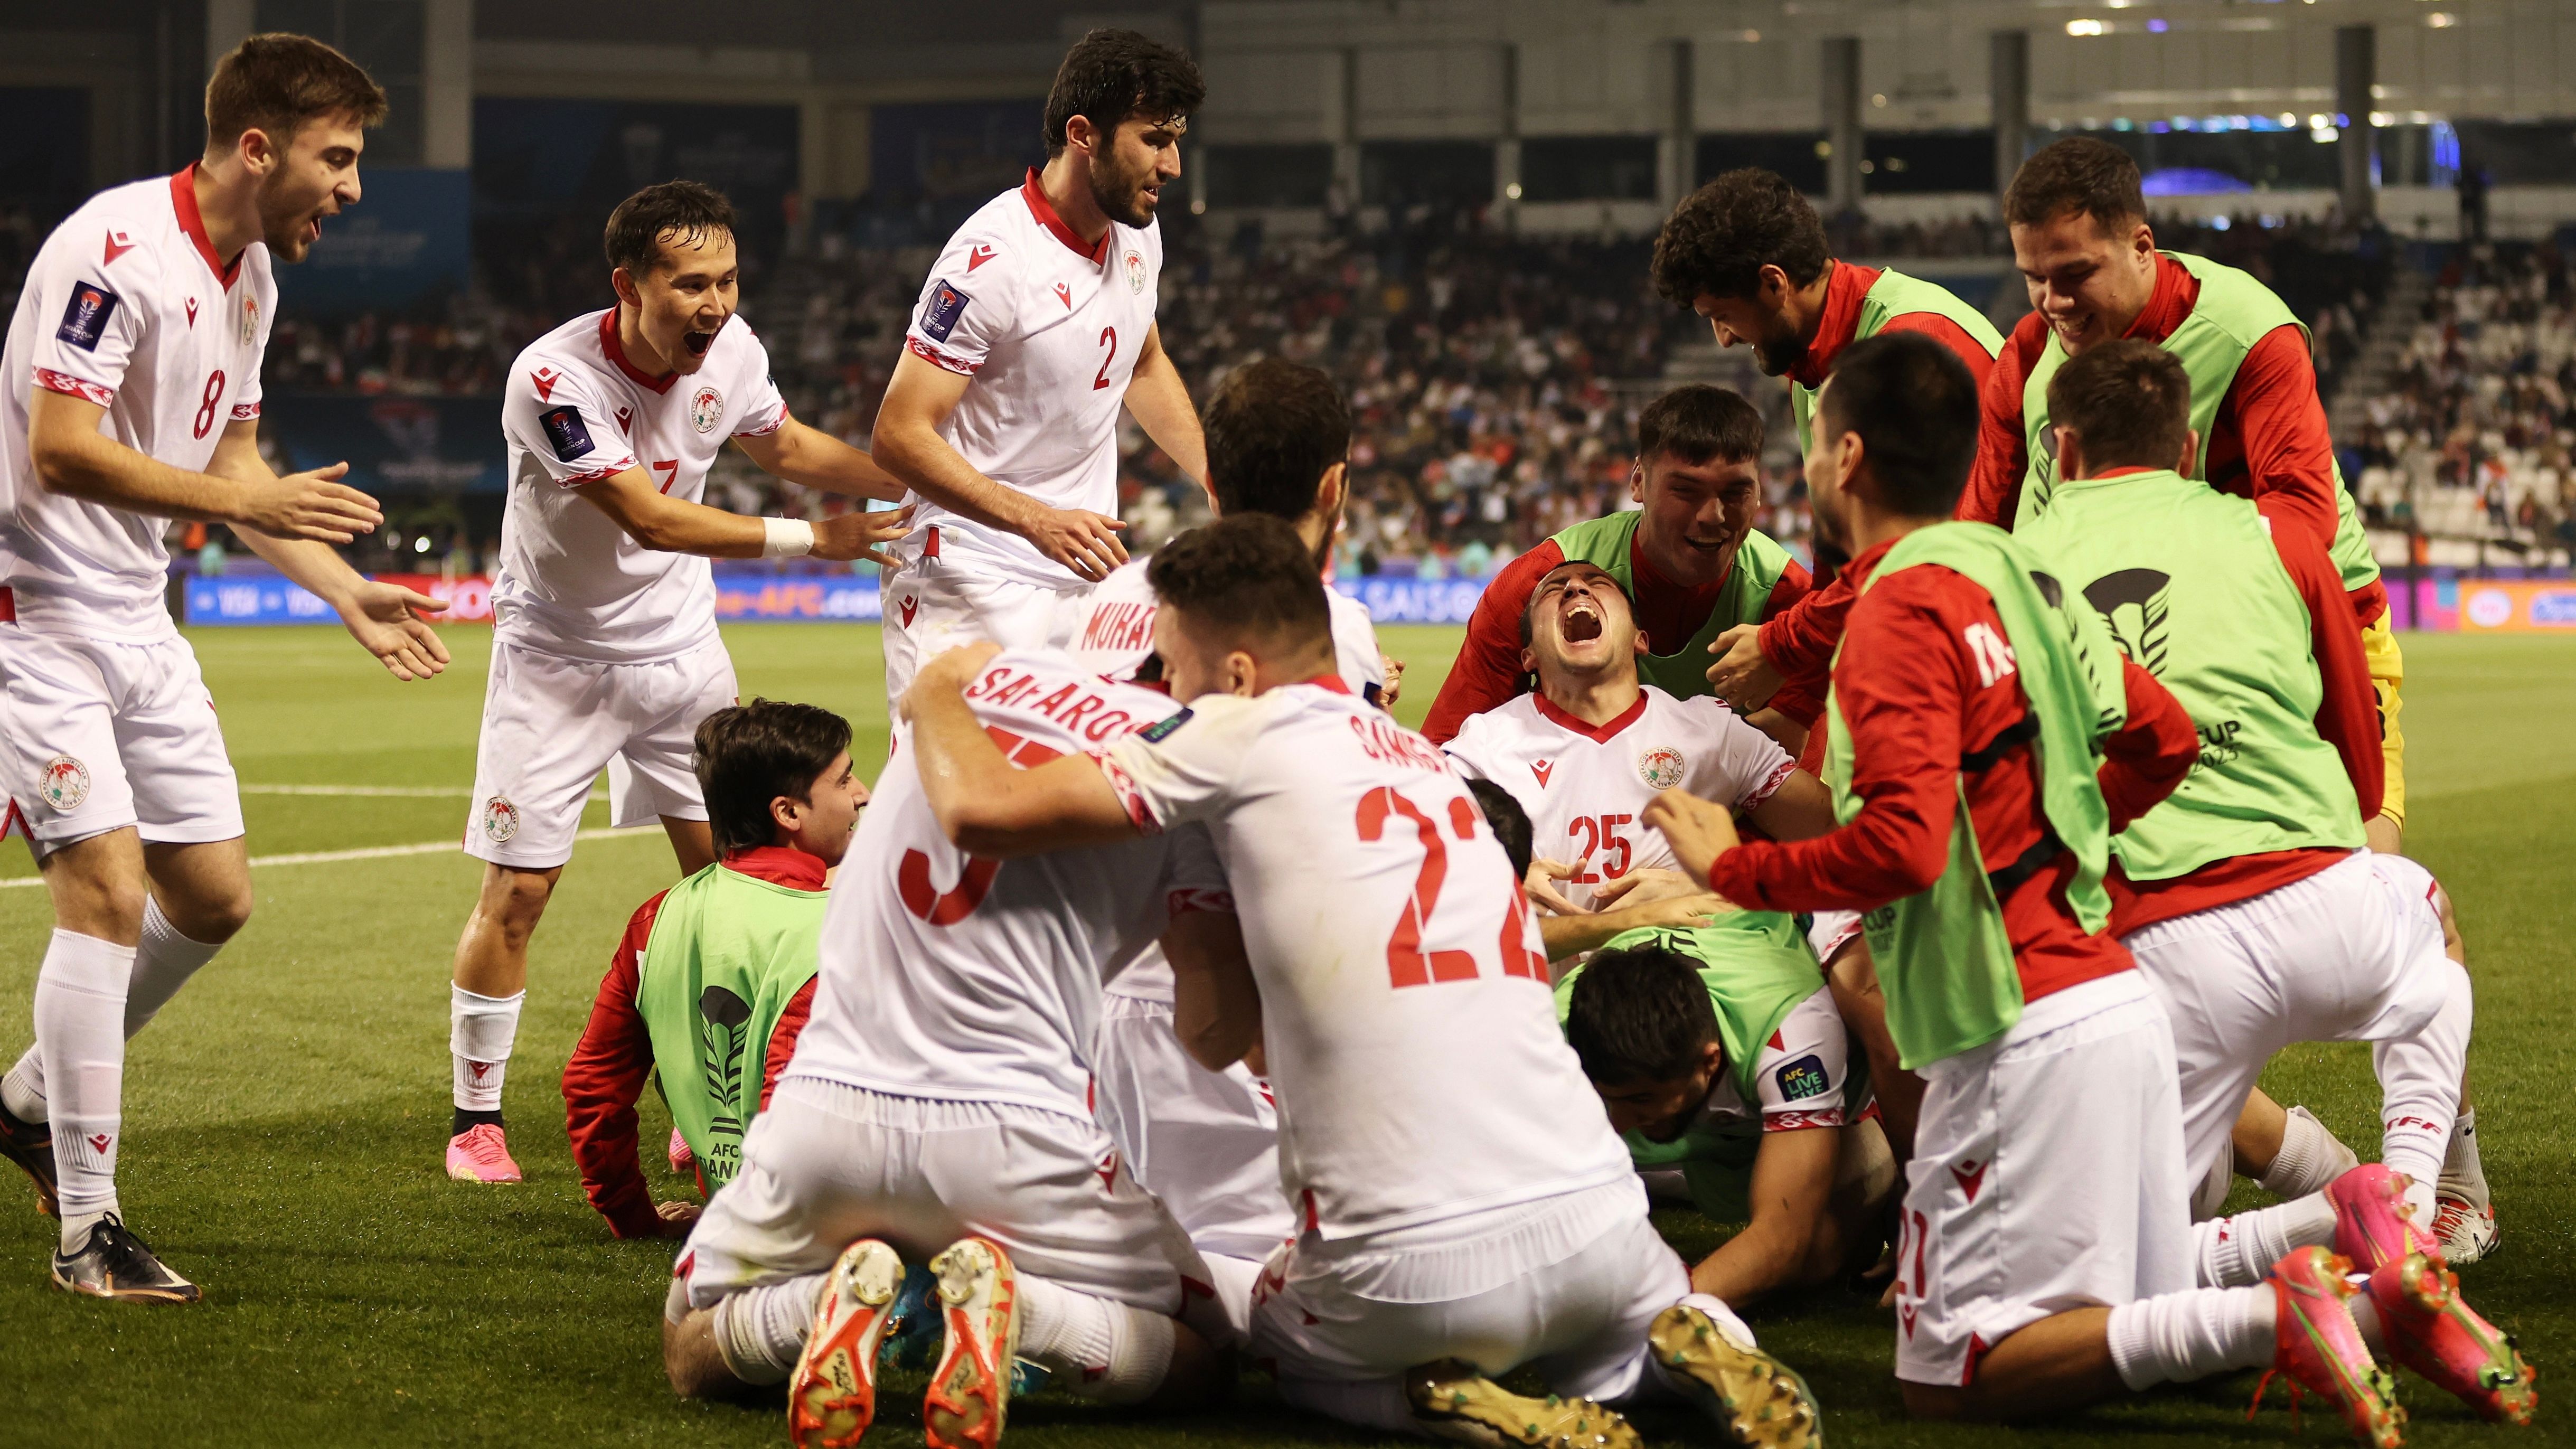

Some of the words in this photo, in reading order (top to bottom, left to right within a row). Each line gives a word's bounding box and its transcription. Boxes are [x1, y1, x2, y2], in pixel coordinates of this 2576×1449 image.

[1093, 326, 1117, 391] 2
[193, 369, 225, 440] 8
[653, 459, 680, 495] 7
[59, 759, 87, 779] TAJIKISTAN
[1641, 754, 1653, 783] FEDERATION
[1657, 749, 1681, 766] TAJIKISTAN
[1657, 770, 1681, 787] FOOTBALL
[62, 785, 87, 807] FOOTBALL
[1568, 814, 1633, 885] 25
[1355, 786, 1550, 990] 22
[1785, 1067, 1806, 1083] AFC
[1787, 1071, 1822, 1095] LIVE
[711, 1143, 739, 1158] AFC
